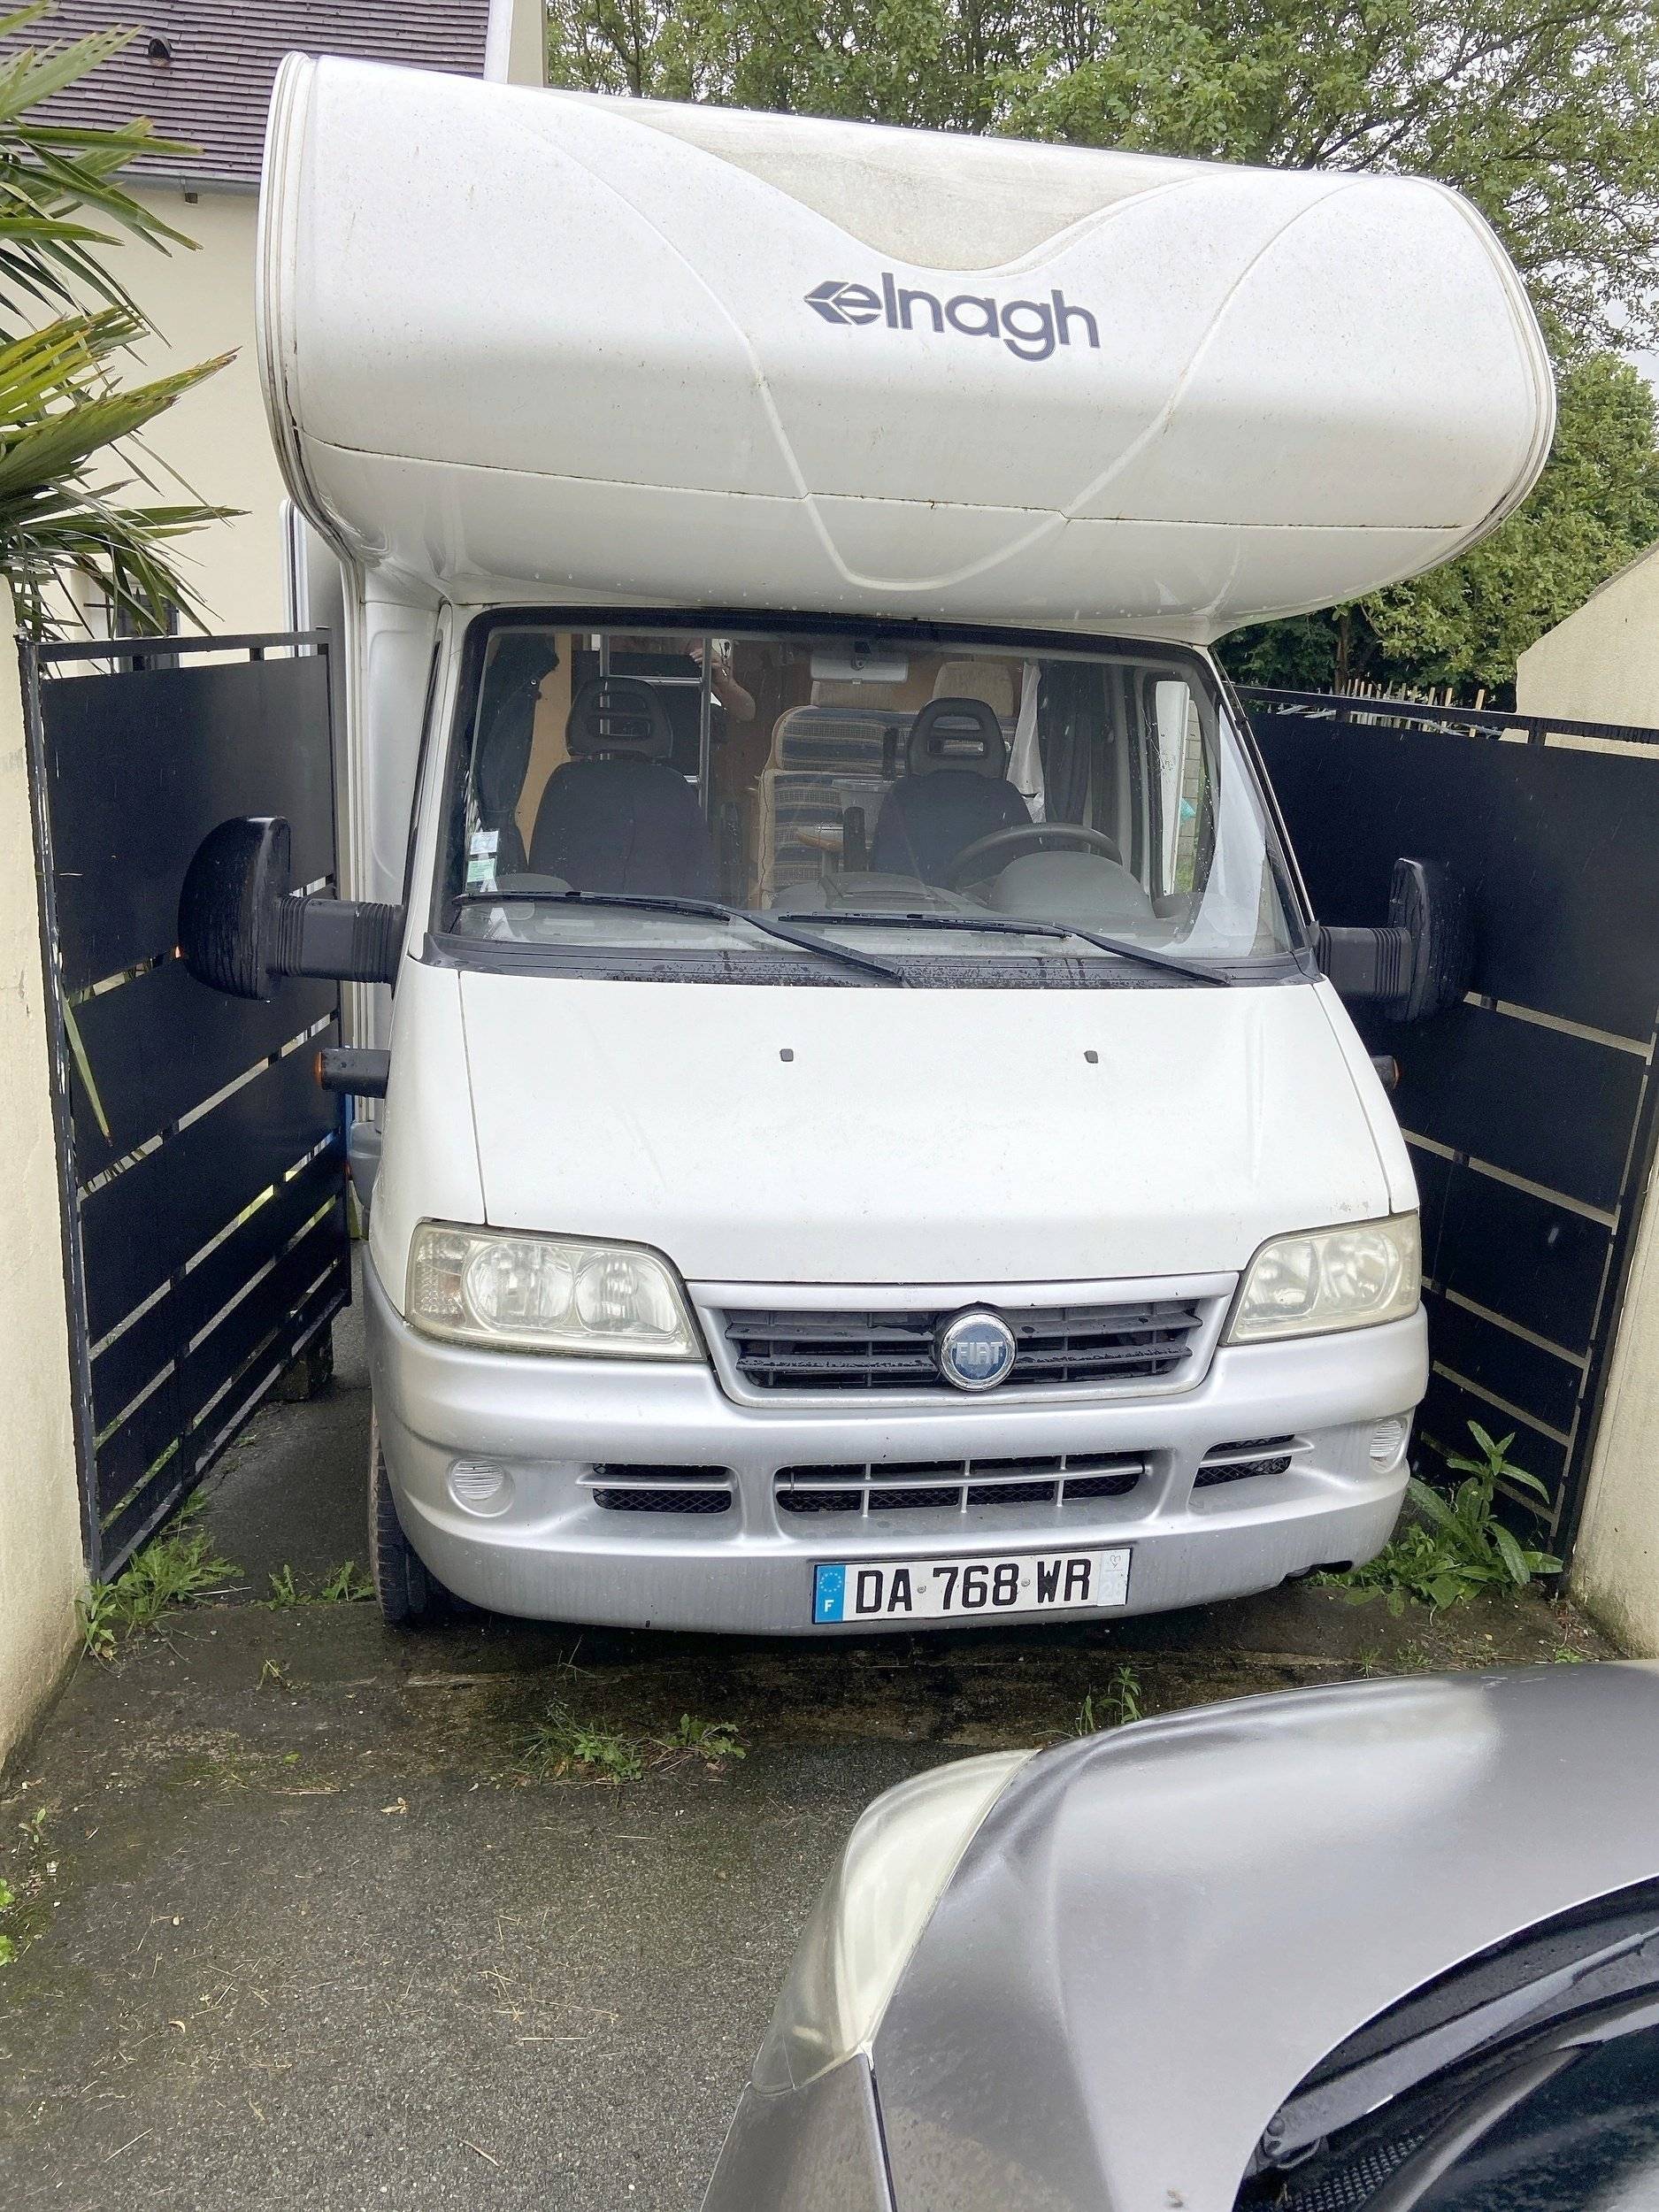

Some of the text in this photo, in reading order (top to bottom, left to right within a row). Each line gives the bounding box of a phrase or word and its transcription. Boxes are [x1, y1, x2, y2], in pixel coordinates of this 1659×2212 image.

[836, 272, 1101, 362] elnagh
[956, 1341, 1003, 1364] FIAT
[856, 1558, 1092, 1614] DA 768 WR
[825, 1599, 834, 1613] F
